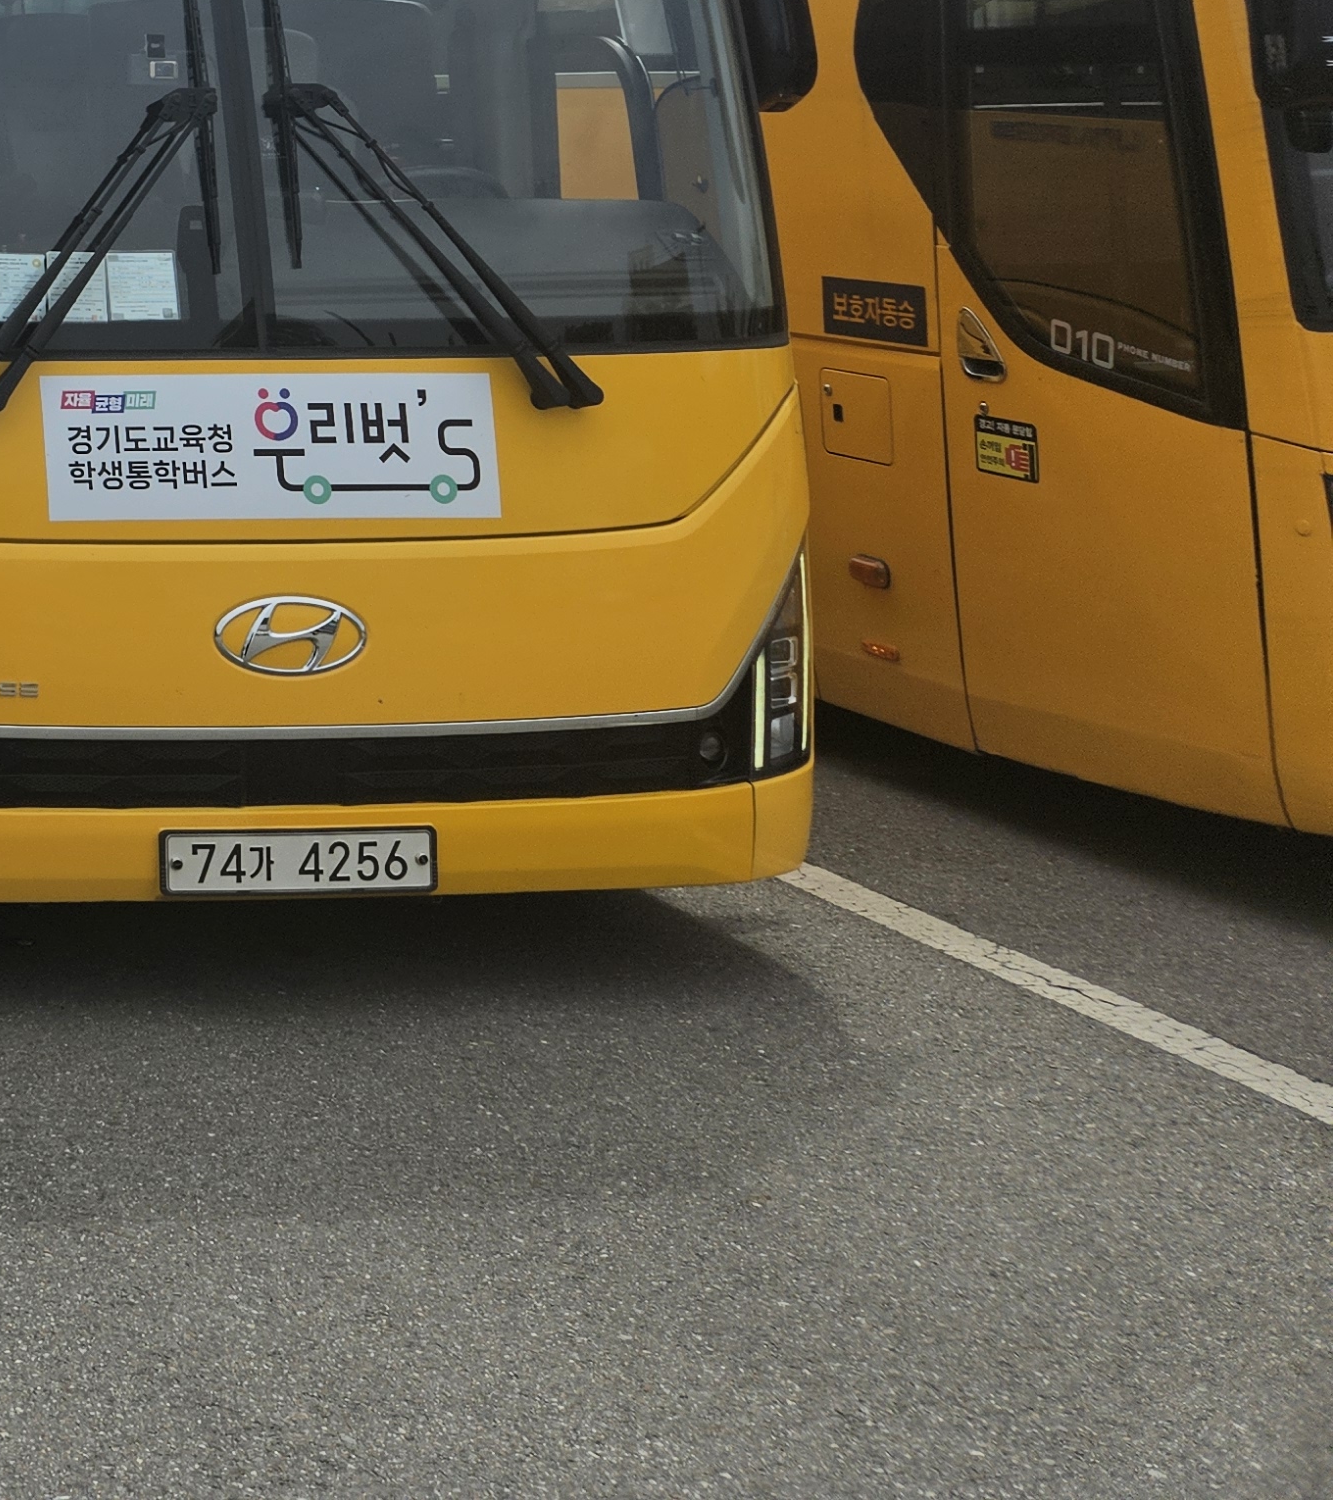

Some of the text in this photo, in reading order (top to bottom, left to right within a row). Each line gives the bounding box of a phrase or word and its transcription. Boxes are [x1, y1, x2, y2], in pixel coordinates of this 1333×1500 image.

[833, 292, 916, 330] 보호자동승
[1050, 318, 1191, 373] 010 PHONE NUMBER
[64, 392, 153, 412] 자율 균형 미래
[67, 424, 234, 455] 경기도교육청
[68, 459, 238, 490] 학생통학버스
[191, 839, 409, 884] 74가 4256
